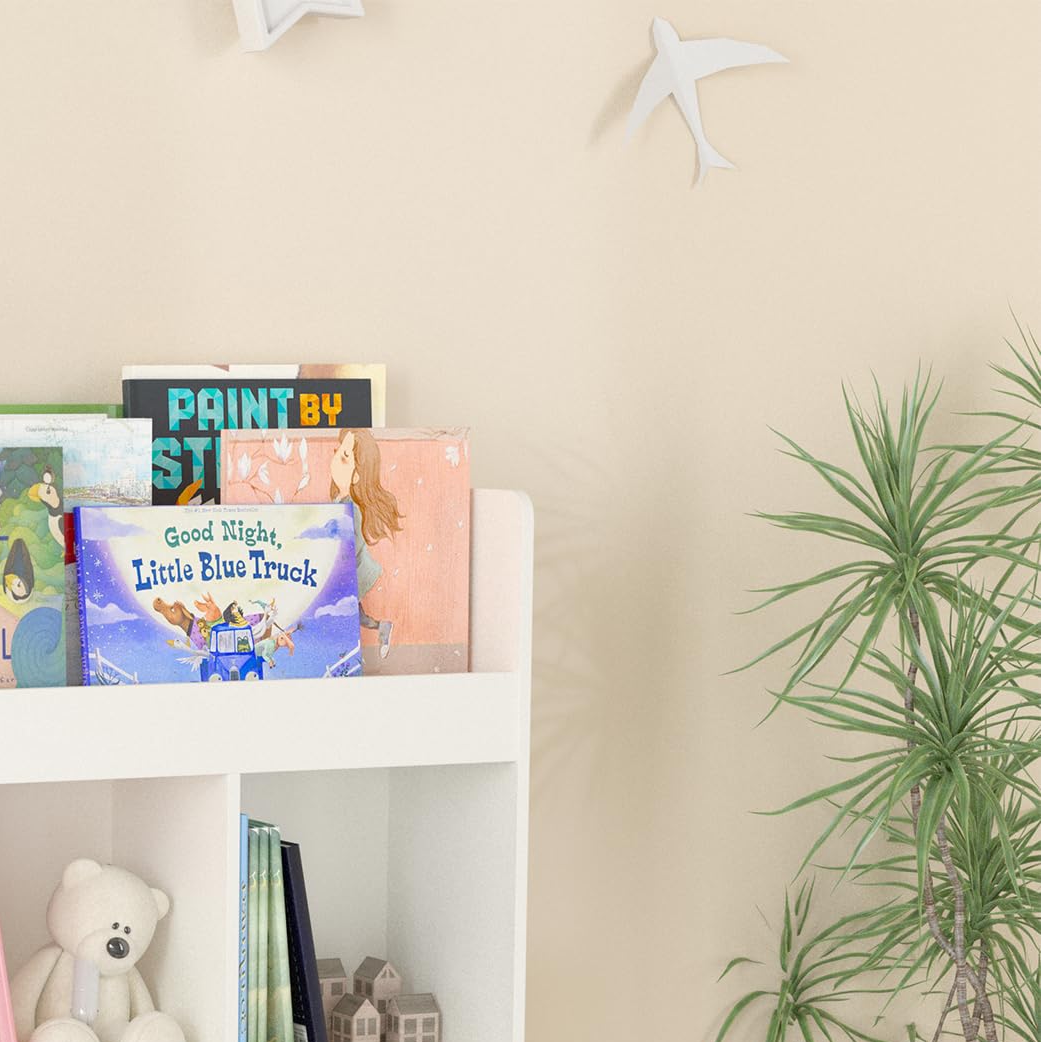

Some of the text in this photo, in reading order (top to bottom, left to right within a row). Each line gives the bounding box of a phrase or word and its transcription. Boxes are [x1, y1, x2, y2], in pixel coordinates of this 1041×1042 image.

[168, 388, 343, 431] PAINT BY
[164, 519, 282, 550] Good Night,
[132, 549, 318, 591] Little Blue Truck
